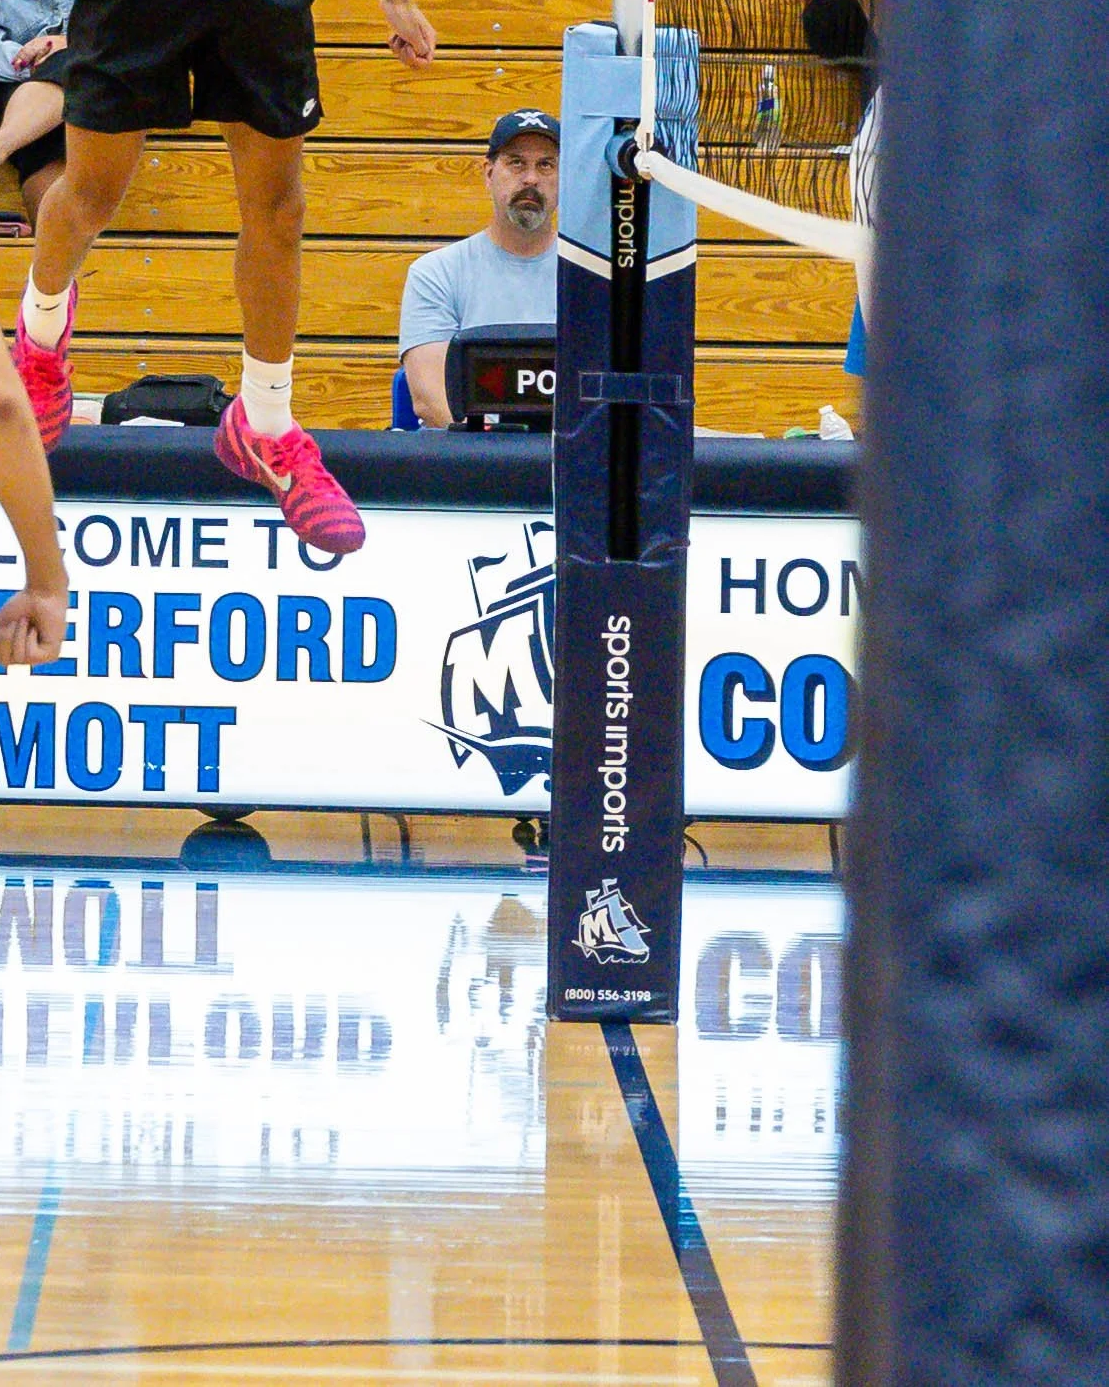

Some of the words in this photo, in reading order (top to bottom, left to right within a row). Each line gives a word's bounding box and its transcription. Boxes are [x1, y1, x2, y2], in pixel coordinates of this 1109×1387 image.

[613, 178, 638, 269] mports
[517, 369, 557, 395] PO
[601, 615, 634, 720] sports
[597, 725, 630, 853] imports
[565, 988, 595, 1002] (800)
[597, 989, 652, 1003] 556-3198
